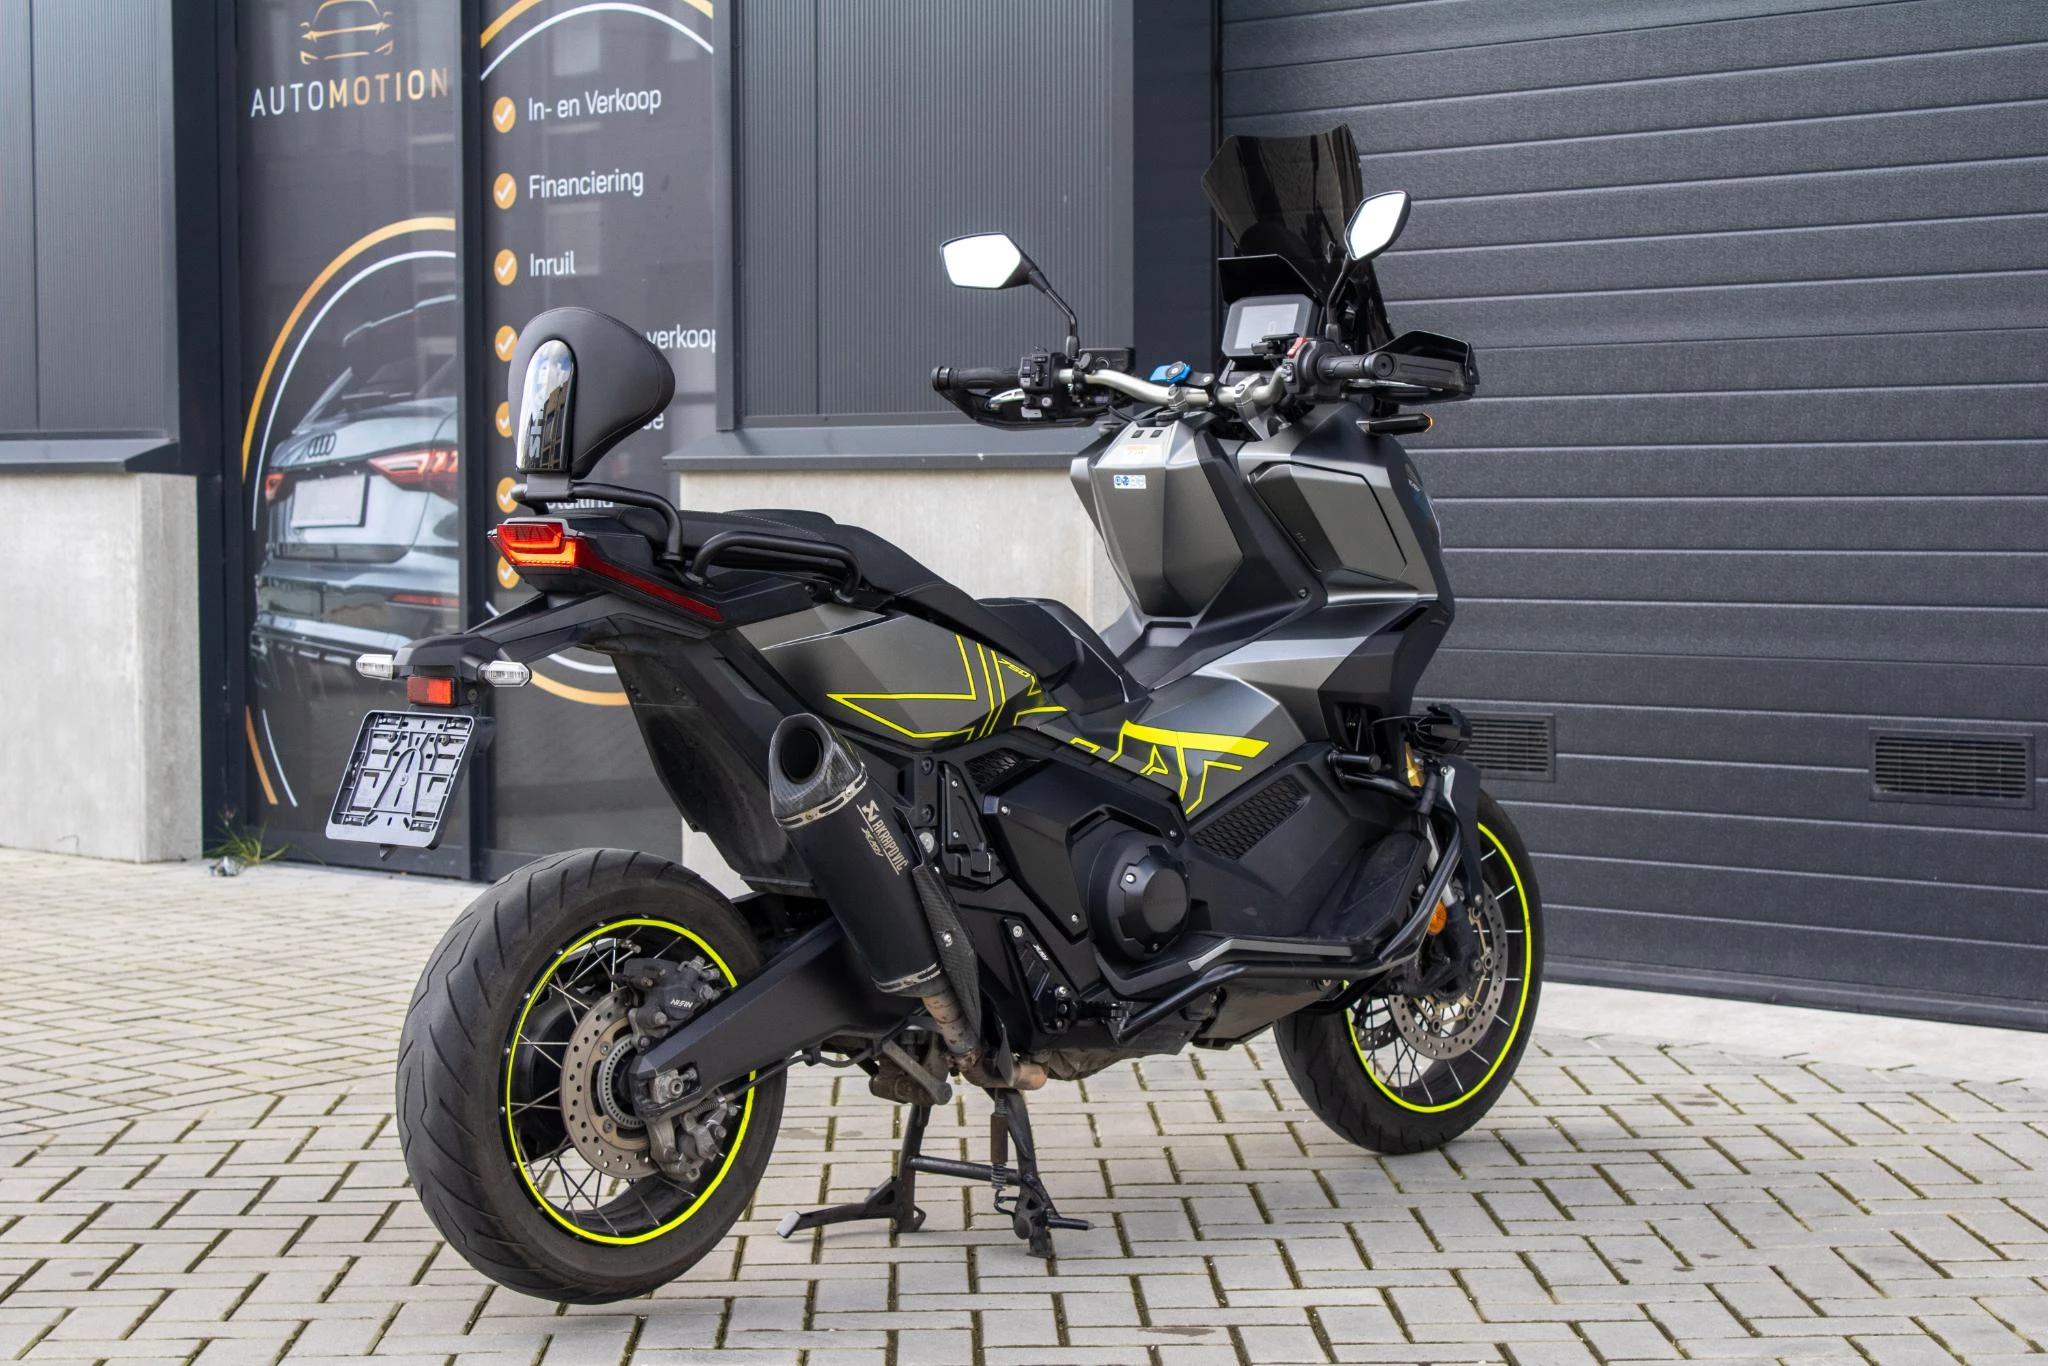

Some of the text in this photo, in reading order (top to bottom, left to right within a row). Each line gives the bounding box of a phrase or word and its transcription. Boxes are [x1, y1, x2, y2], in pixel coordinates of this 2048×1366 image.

[250, 67, 448, 118] AUTOMOTION
[528, 87, 661, 121] In- en Verkoop
[529, 168, 644, 199] Financiering
[530, 250, 576, 277] Inruil
